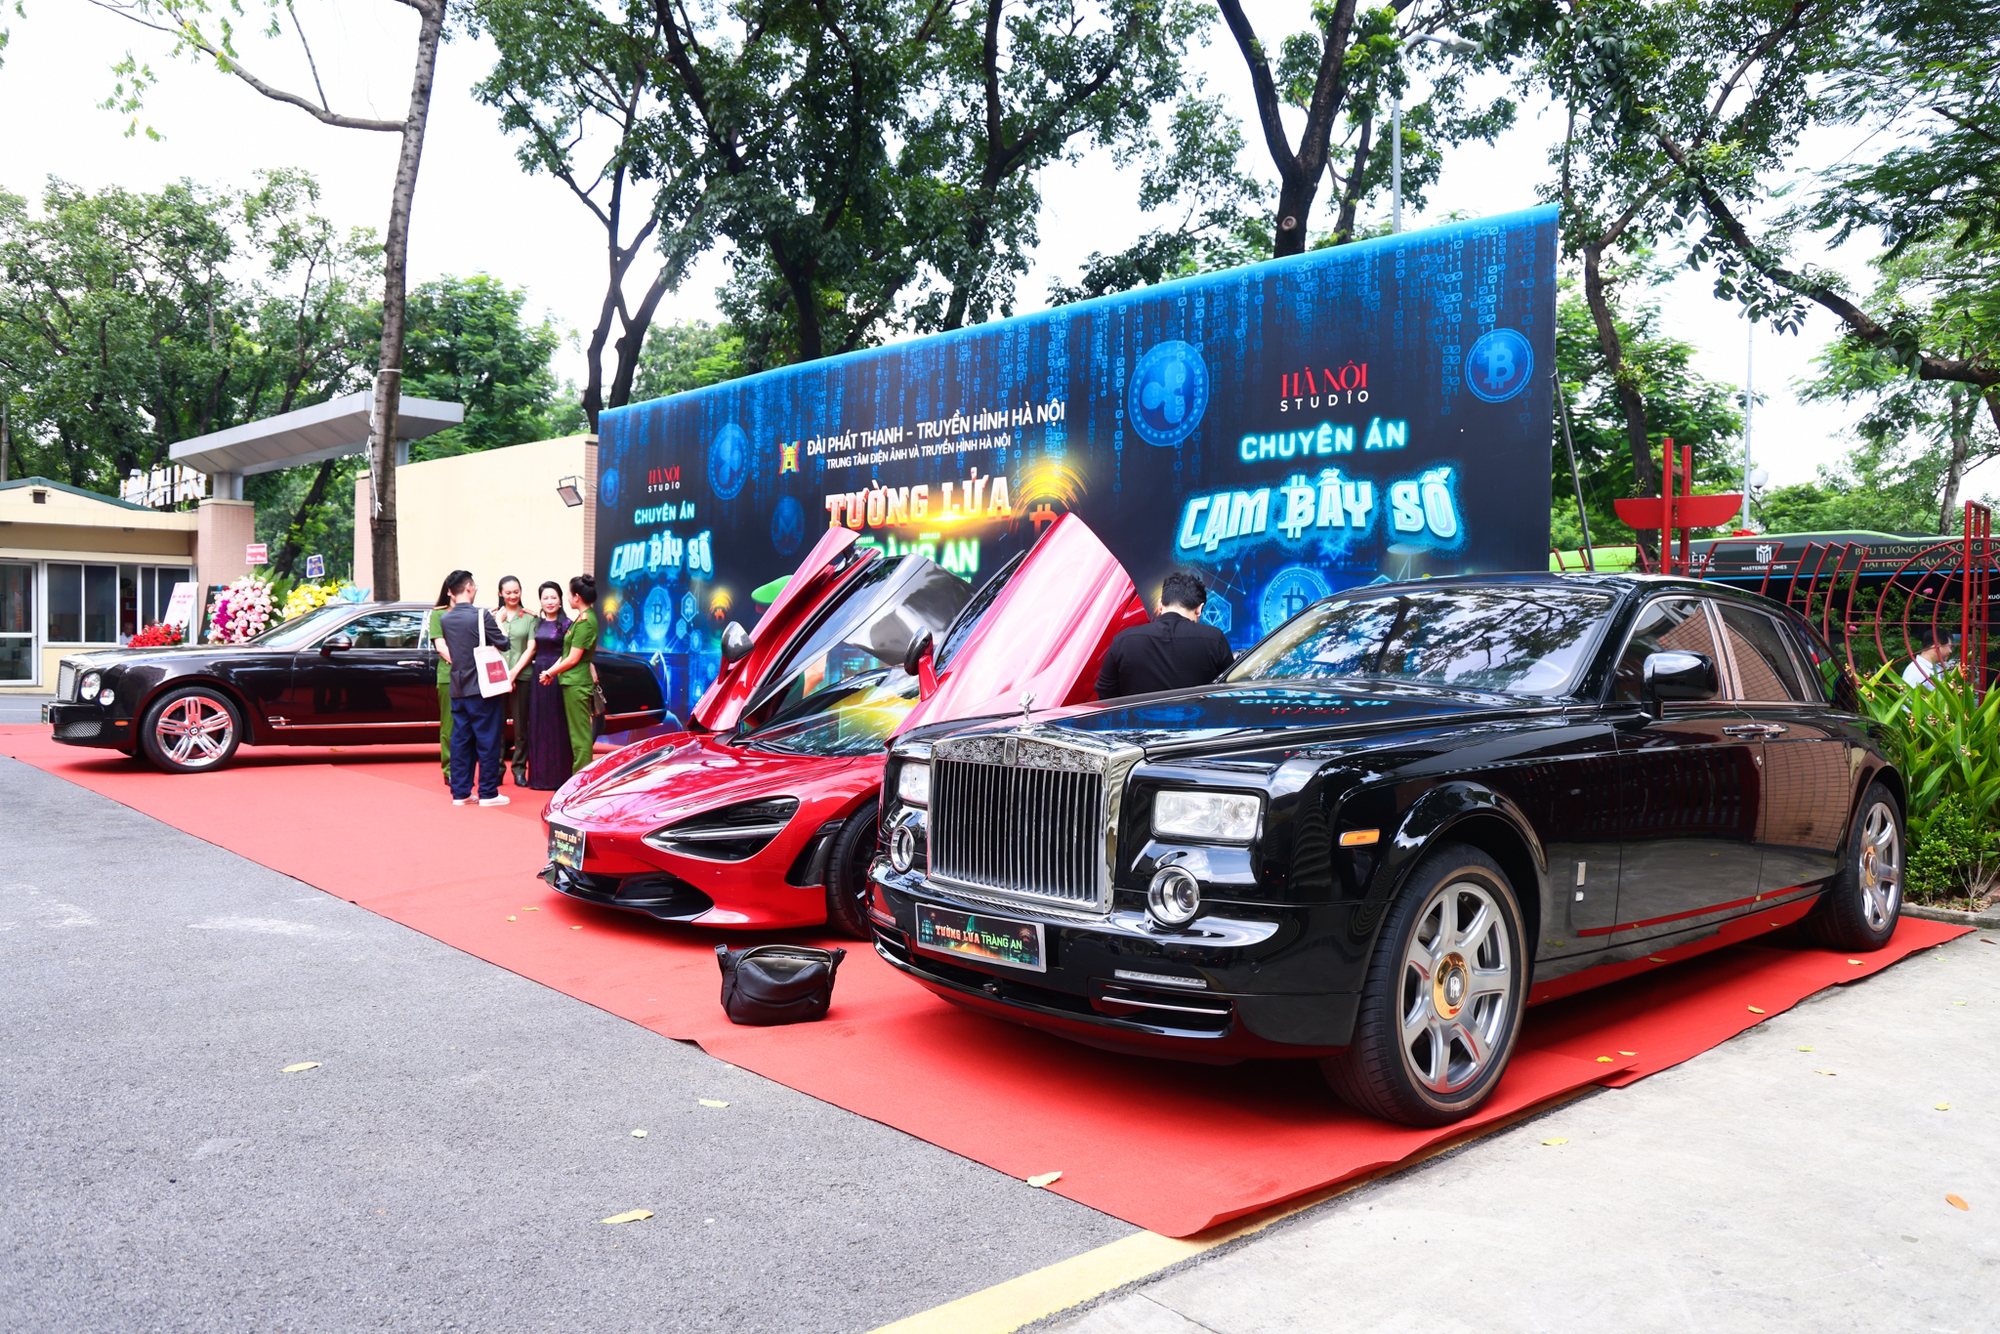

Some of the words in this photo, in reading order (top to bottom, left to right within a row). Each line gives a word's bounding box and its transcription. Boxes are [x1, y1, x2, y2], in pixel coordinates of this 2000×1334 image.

[1280, 390, 1369, 412] STUDIO
[807, 434, 826, 456] ĐÀI
[828, 429, 858, 453] PHÁT
[860, 426, 903, 448] THANH
[916, 409, 970, 440] TRUYỀN
[972, 408, 1009, 432] HÌNH
[1011, 401, 1034, 427] HÀ
[1036, 397, 1065, 427] NỘI
[1241, 423, 1353, 460] CHUYÊN
[1364, 417, 1405, 449] ÁN
[826, 457, 852, 469] TRUNG
[852, 452, 869, 466] TÂM
[870, 449, 889, 466] ĐIỆN
[889, 447, 908, 461] ẢNH
[908, 444, 920, 458] VÀ
[921, 438, 955, 457] TRUYỀN
[955, 437, 978, 454] HÌNH
[978, 434, 993, 450] HÀ
[993, 432, 1011, 450] NỘI
[648, 481, 680, 493] STUDIO
[825, 479, 929, 530] TƯỜNG
[941, 466, 1012, 520] LỬA
[634, 502, 677, 525] CHUYÊN
[679, 500, 695, 519] ÁN
[1179, 488, 1270, 553] CẠM
[1390, 467, 1457, 538] SỐ
[610, 541, 646, 581] CẠM
[687, 530, 712, 573] SỐ
[941, 540, 979, 574] AN
[1855, 544, 1876, 556] BIU
[981, 933, 1009, 948] TRÀNG
[1011, 939, 1023, 950] AN
